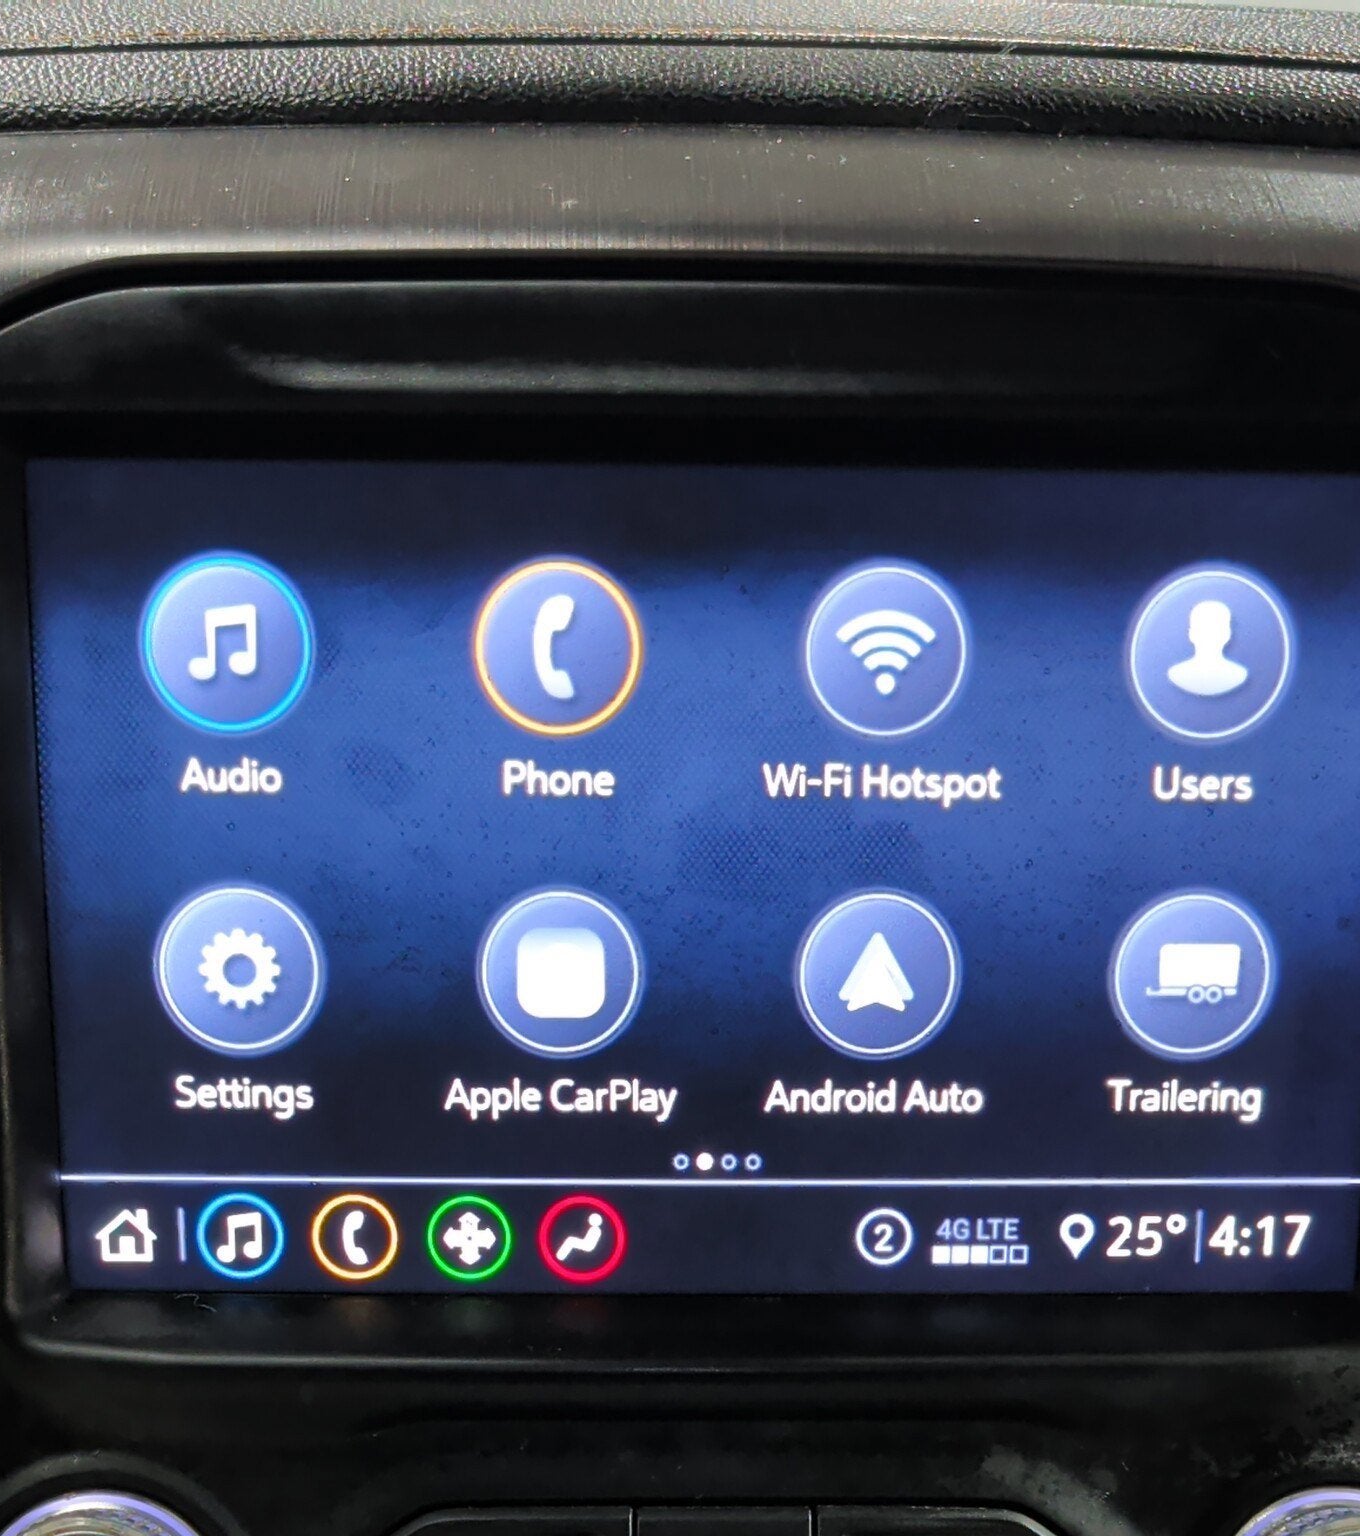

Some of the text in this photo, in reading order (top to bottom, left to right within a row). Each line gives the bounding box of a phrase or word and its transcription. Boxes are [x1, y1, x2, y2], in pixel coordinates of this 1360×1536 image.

[180, 757, 283, 794] Audio
[502, 758, 616, 797] Phone
[762, 761, 1002, 809] Wi-Fi Hotspot
[1153, 765, 1254, 802] Users
[175, 1075, 314, 1120] Settings
[444, 1078, 678, 1122] Apple CarPlay
[764, 1079, 984, 1114] Android Auto
[1106, 1079, 1263, 1124] Trailering
[936, 1217, 1020, 1241] 4G LTE
[1106, 1213, 1188, 1258] 25°
[1208, 1214, 1312, 1257] 4:17
